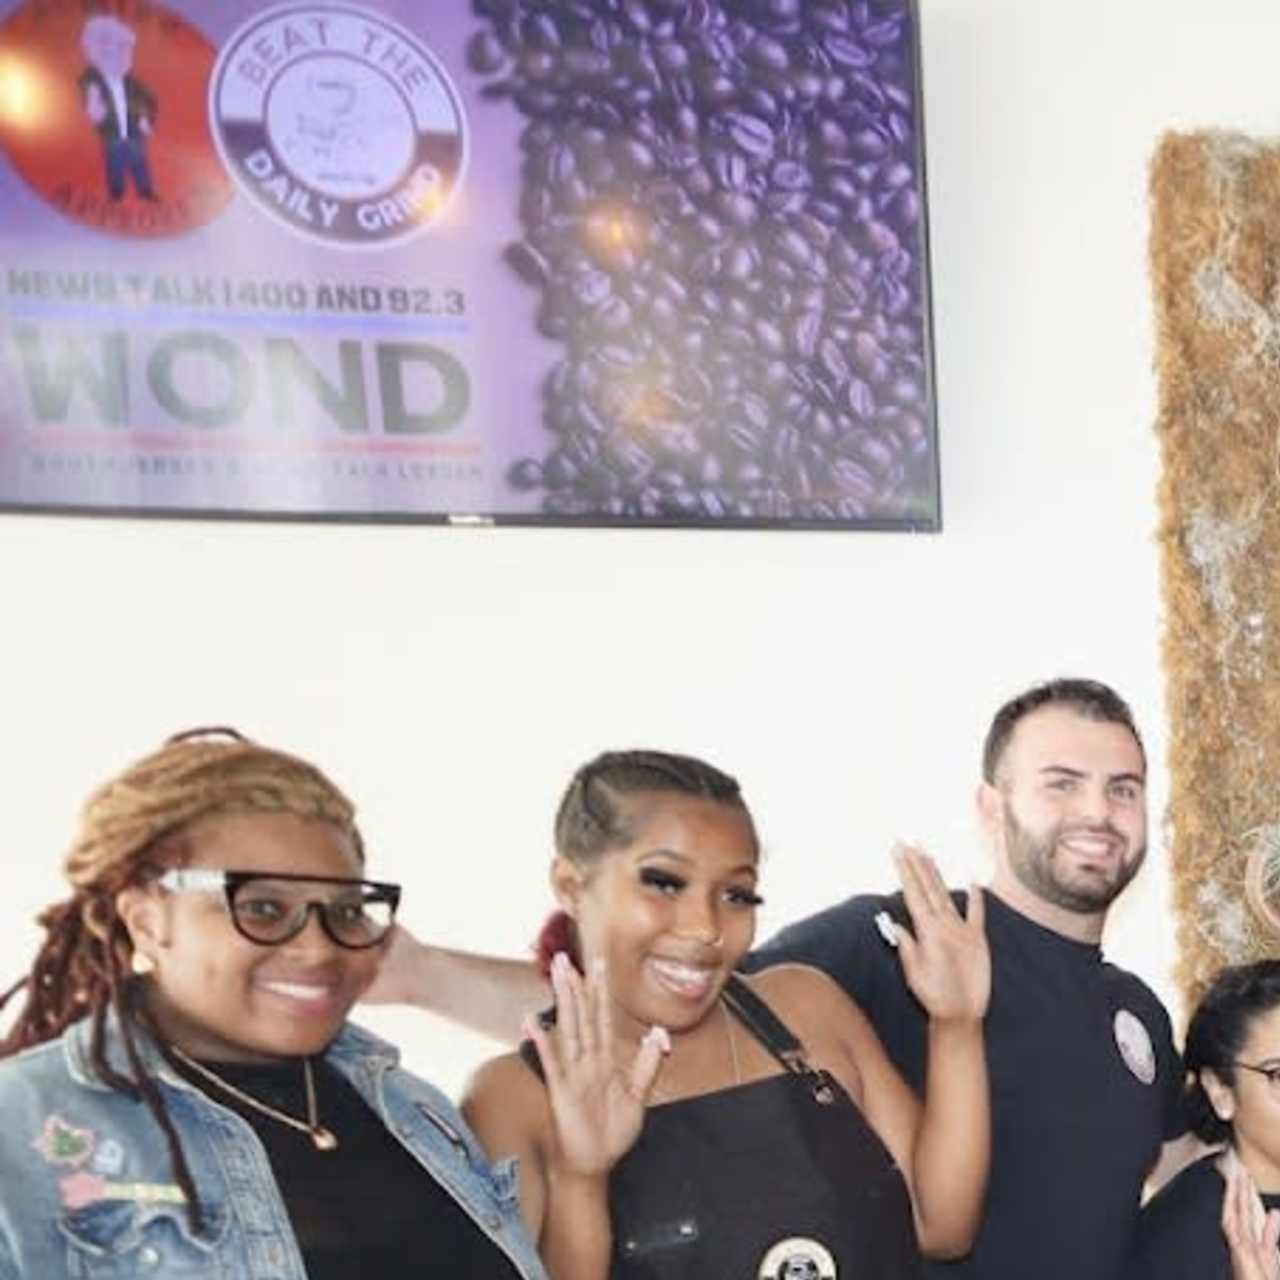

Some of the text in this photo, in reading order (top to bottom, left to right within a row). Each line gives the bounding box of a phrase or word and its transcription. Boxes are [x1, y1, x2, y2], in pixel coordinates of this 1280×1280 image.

[238, 19, 333, 88] BEAT
[361, 29, 431, 97] THE
[243, 148, 341, 230] DAILY
[315, 286, 383, 312] AND
[12, 325, 473, 436] WOND
